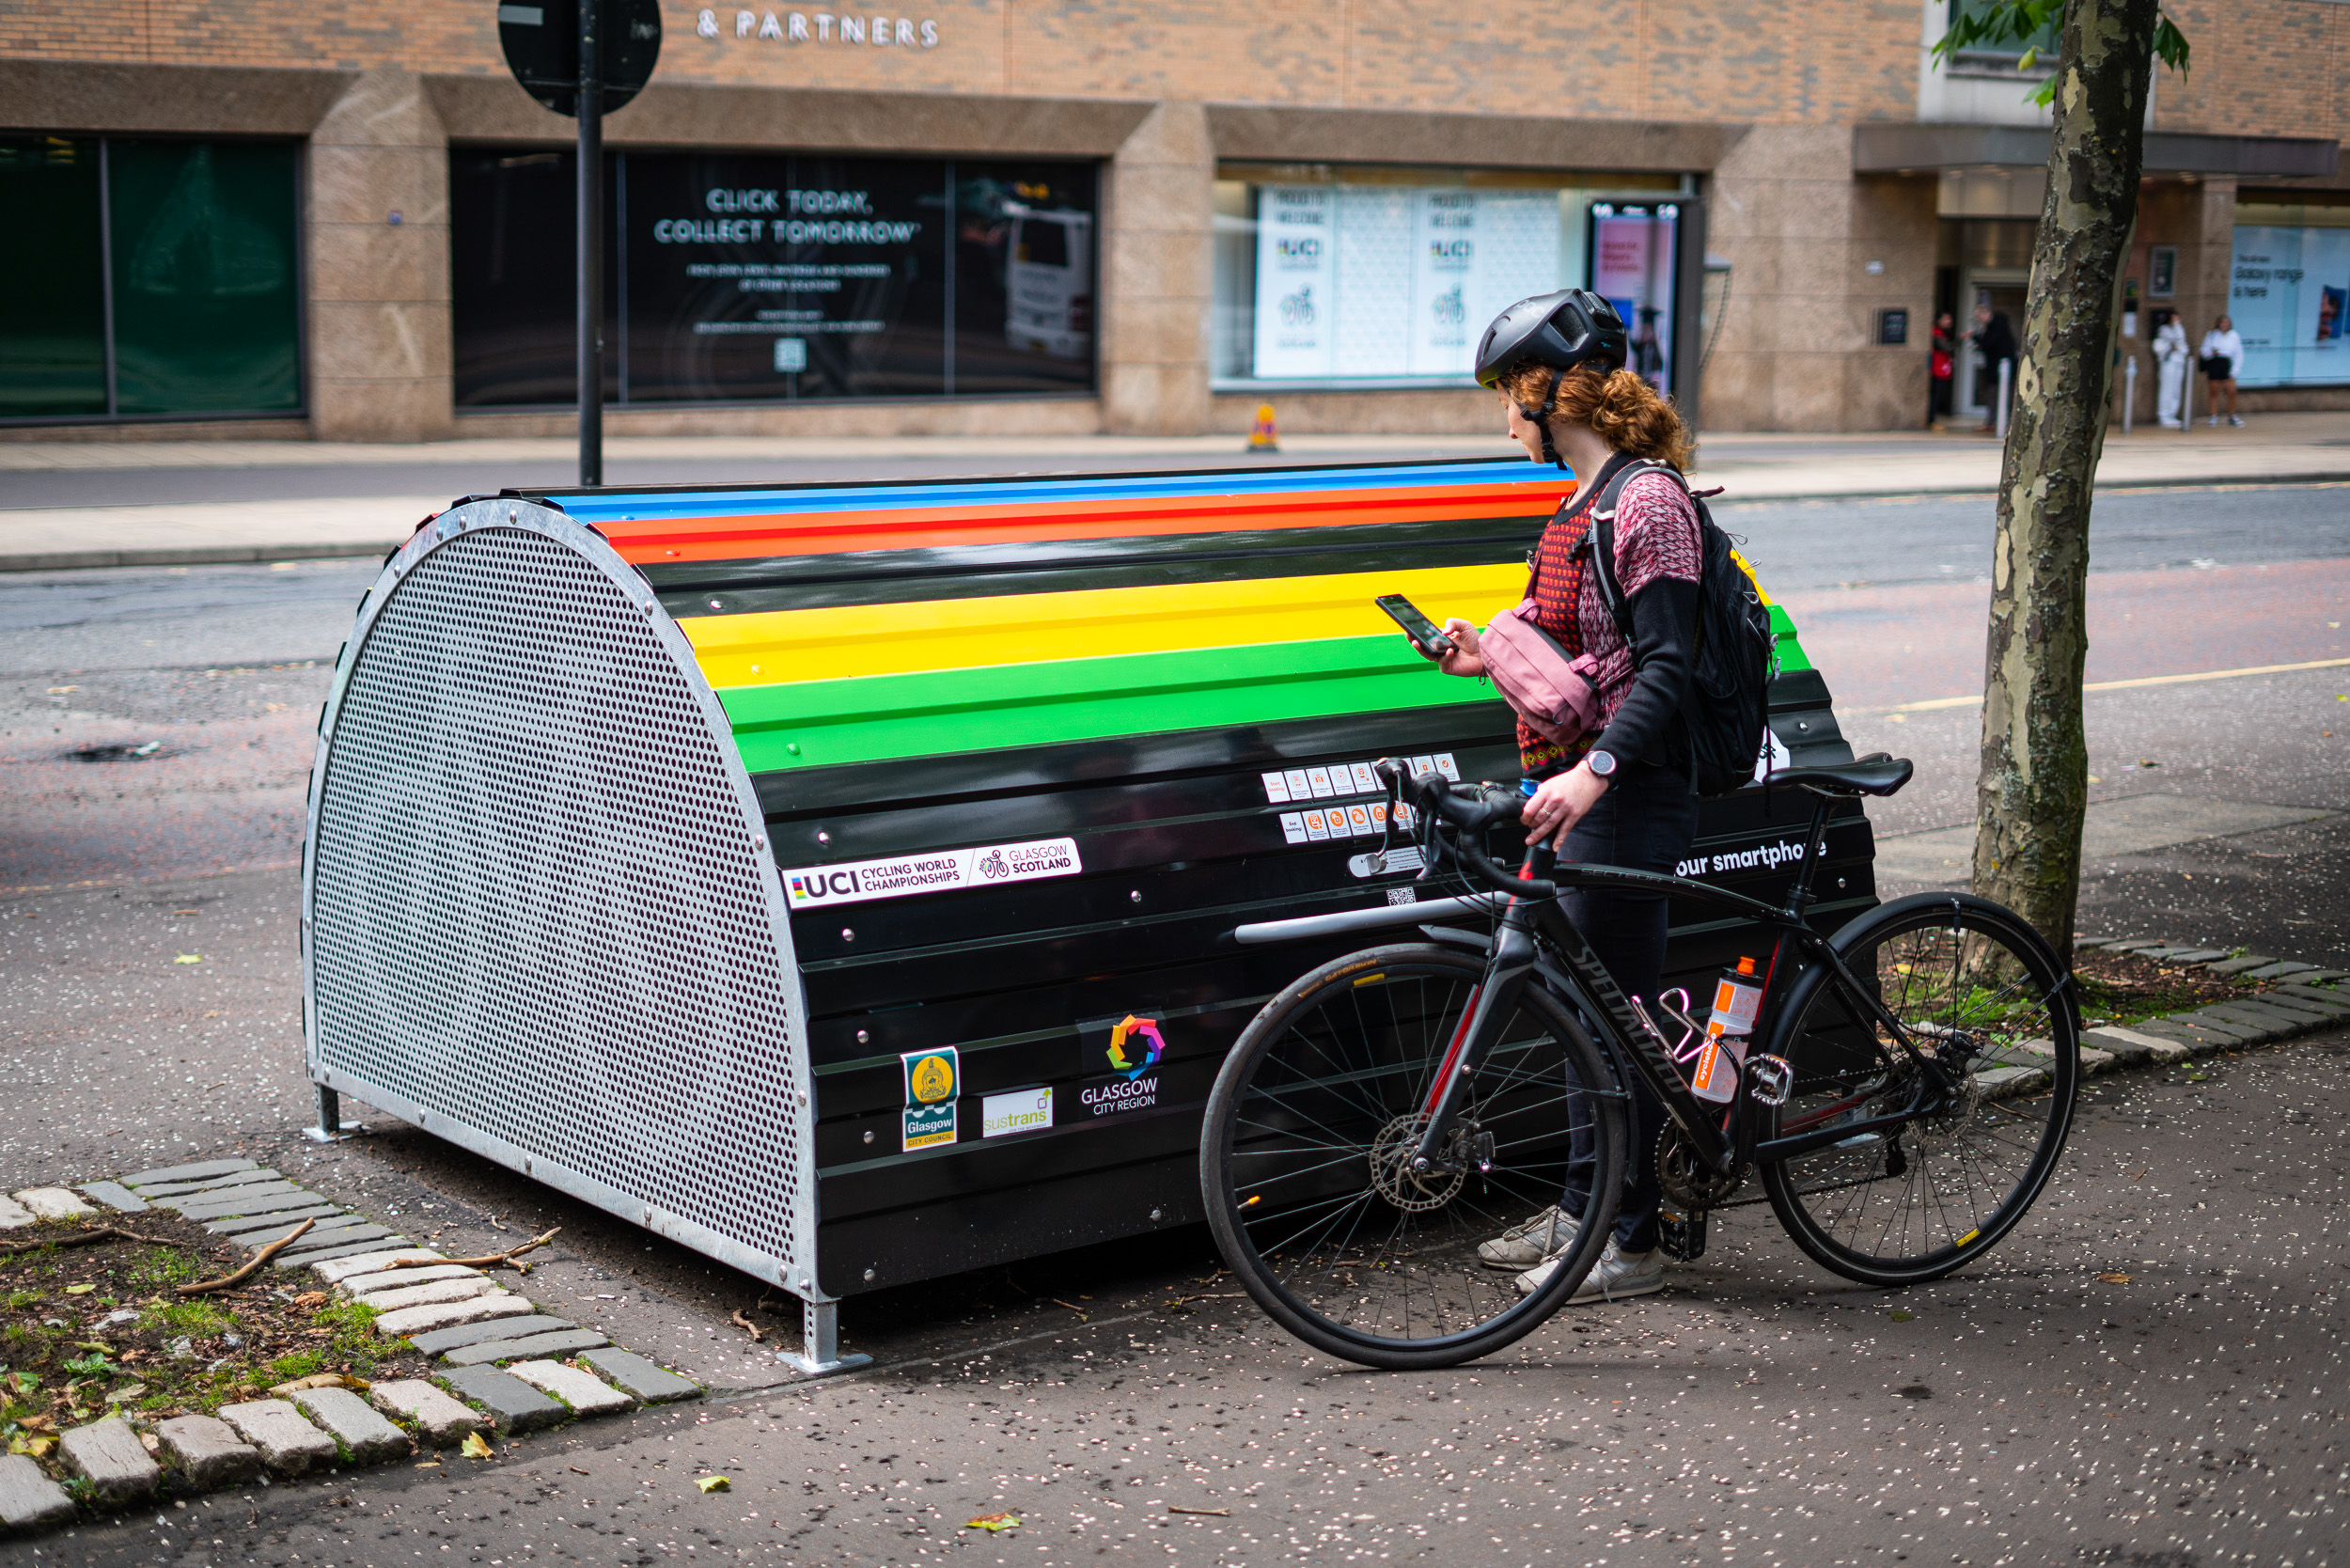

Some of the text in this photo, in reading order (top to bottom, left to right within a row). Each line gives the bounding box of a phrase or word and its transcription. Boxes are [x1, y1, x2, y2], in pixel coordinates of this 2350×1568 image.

[697, 8, 938, 47] & PARTNERS
[706, 188, 873, 214] CLICK TODAY,
[654, 218, 765, 243] COLLECT
[1009, 845, 1068, 862] GLASGOW
[1674, 839, 1826, 877] our smartphoe
[861, 858, 957, 880] CYCLING WORLD
[1012, 857, 1071, 874] SCOTLAND
[1580, 868, 1662, 883] SECTEUR
[804, 870, 860, 898] UCI
[865, 870, 960, 892] CHAMPIONSHIPS
[1566, 946, 1688, 1093] SPECIALIZED
[1081, 1077, 1158, 1105] GLASGOW
[1093, 1094, 1155, 1116] CITY REGION
[907, 1118, 952, 1135] Glasgow
[983, 1110, 1047, 1132] sustrans
[907, 1133, 952, 1147] CITY COUNCIL
